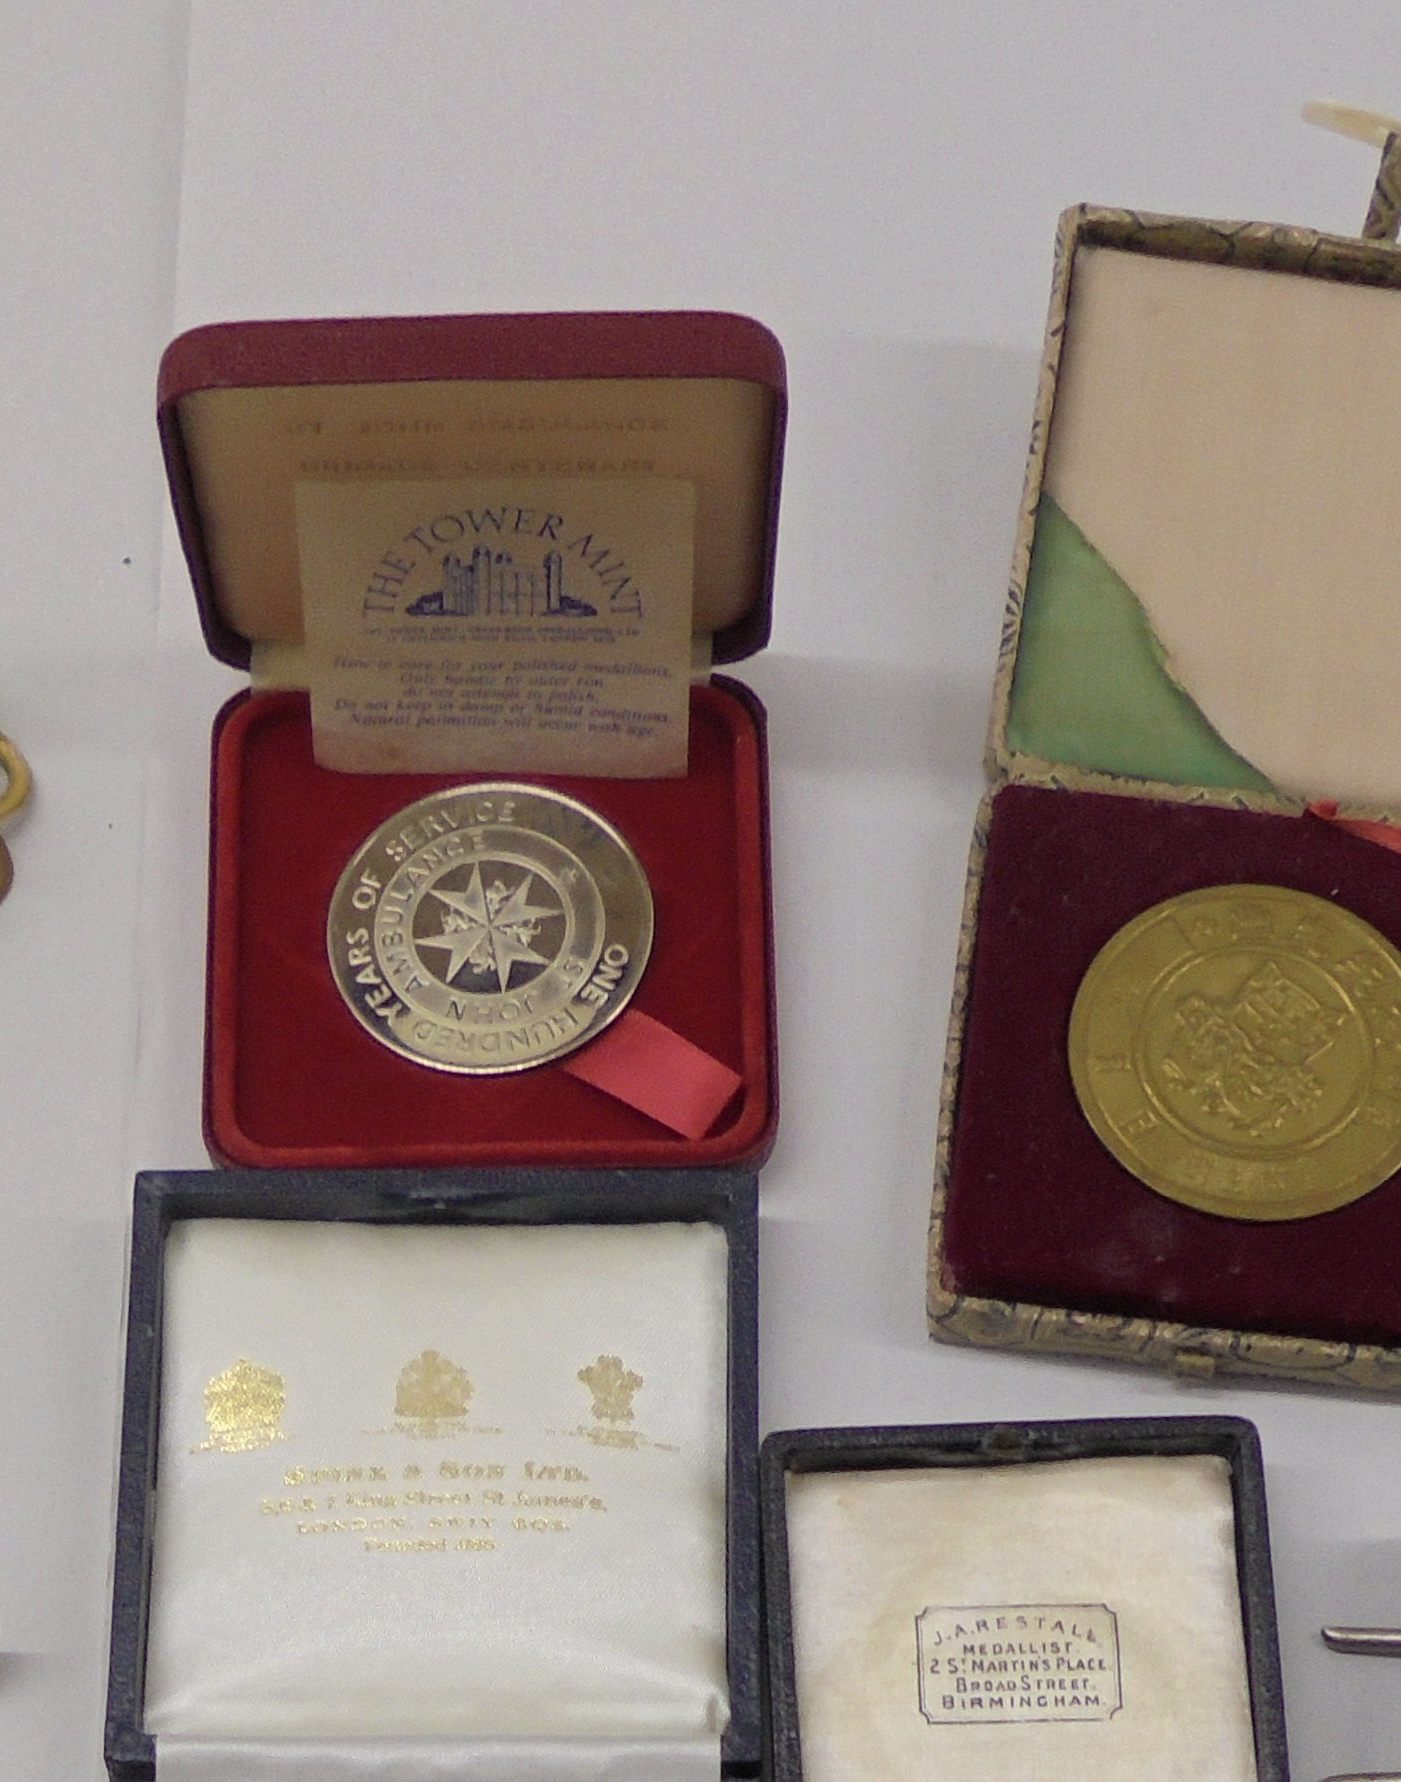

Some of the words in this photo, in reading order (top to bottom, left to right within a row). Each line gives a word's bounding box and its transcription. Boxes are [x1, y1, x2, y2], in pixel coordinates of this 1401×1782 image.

[364, 548, 417, 618] THE
[402, 505, 566, 551] TOWER
[569, 530, 644, 619] MINT
[385, 799, 517, 863] SERVICE
[351, 873, 383, 911] OF
[381, 830, 487, 994] AMBULANCE
[346, 926, 407, 1024] YEARS
[580, 942, 629, 1011] ONE
[412, 1008, 580, 1057] HUNDRED
[929, 1658, 941, 1674] 2
